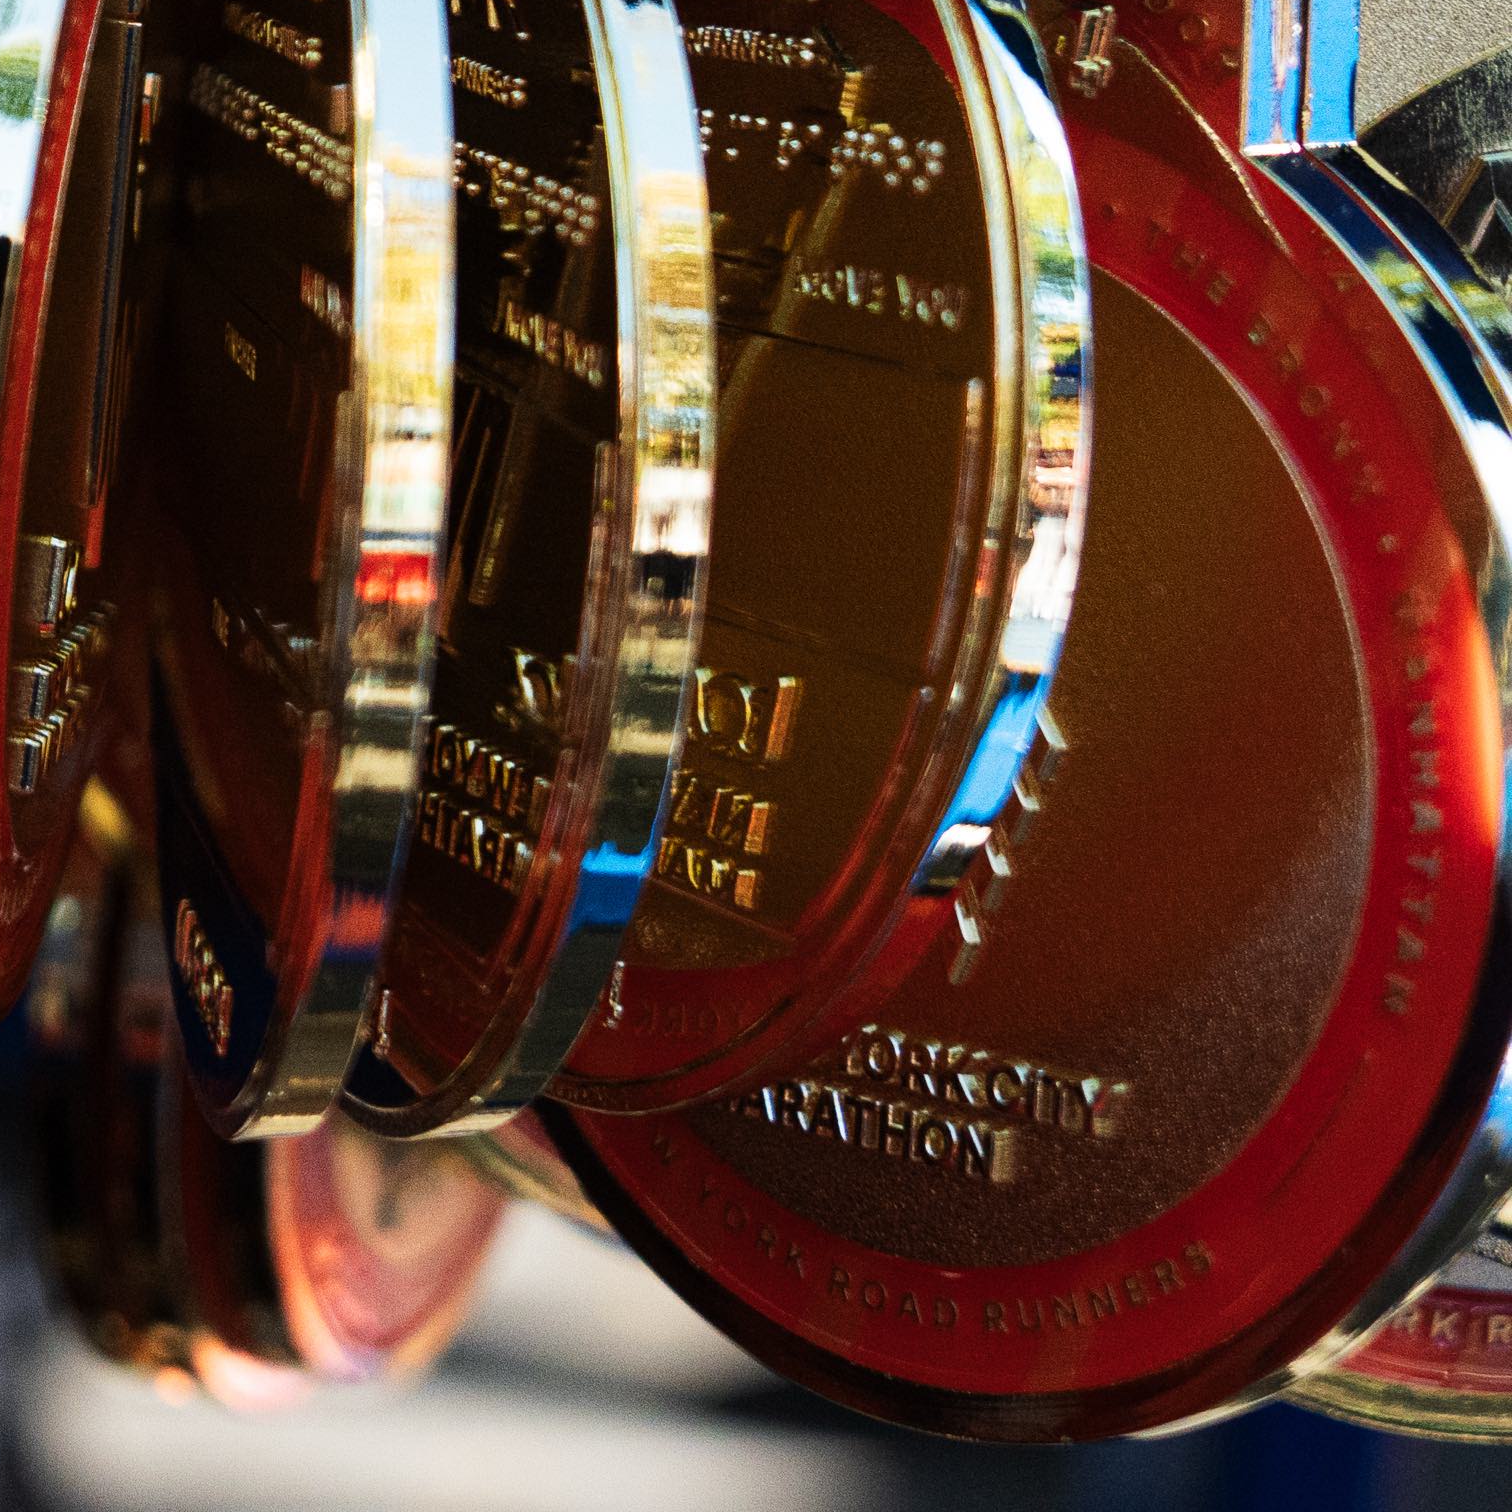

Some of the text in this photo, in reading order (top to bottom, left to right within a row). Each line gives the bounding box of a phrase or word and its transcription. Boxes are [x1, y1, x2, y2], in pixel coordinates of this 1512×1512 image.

[726, 1078, 1016, 1184] ARATHON
[828, 1266, 963, 1331] ROAD
[980, 1237, 1216, 1336] RUNNERS
